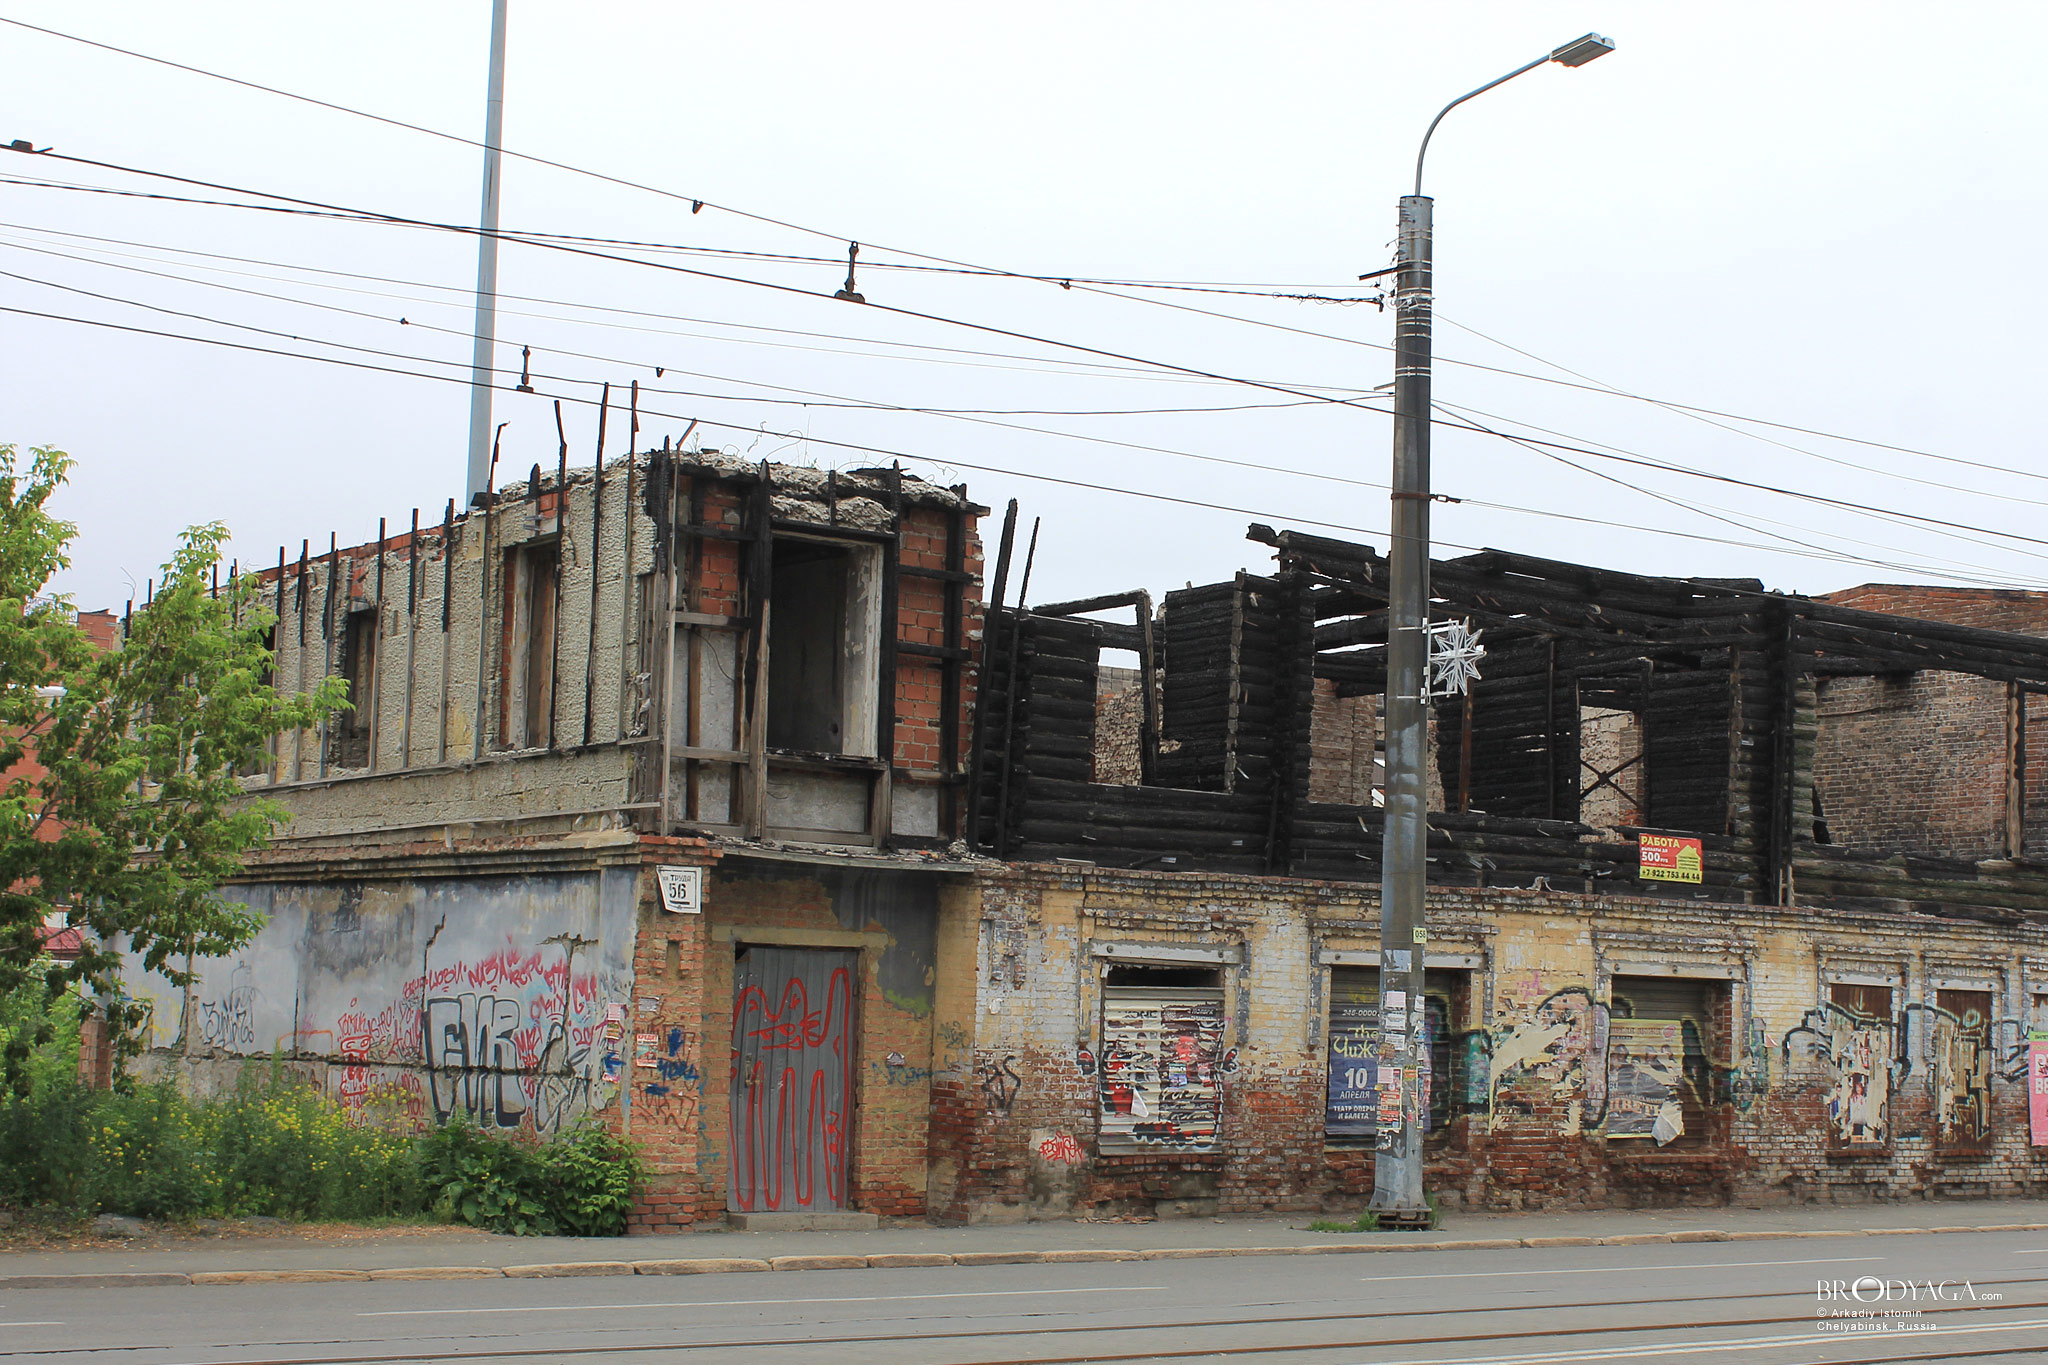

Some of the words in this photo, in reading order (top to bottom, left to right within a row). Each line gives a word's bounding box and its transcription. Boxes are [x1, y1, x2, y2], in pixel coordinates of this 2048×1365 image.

[1641, 836, 1680, 848] РАБОТА
[1641, 851, 1660, 862] 500
[1652, 870, 1665, 878] 922
[1666, 871, 1679, 879] 753
[669, 882, 687, 899] 56
[1347, 1023, 1379, 1039] The
[1344, 1067, 1368, 1089] 10
[1340, 1090, 1370, 1099] АПРЕЛЯ
